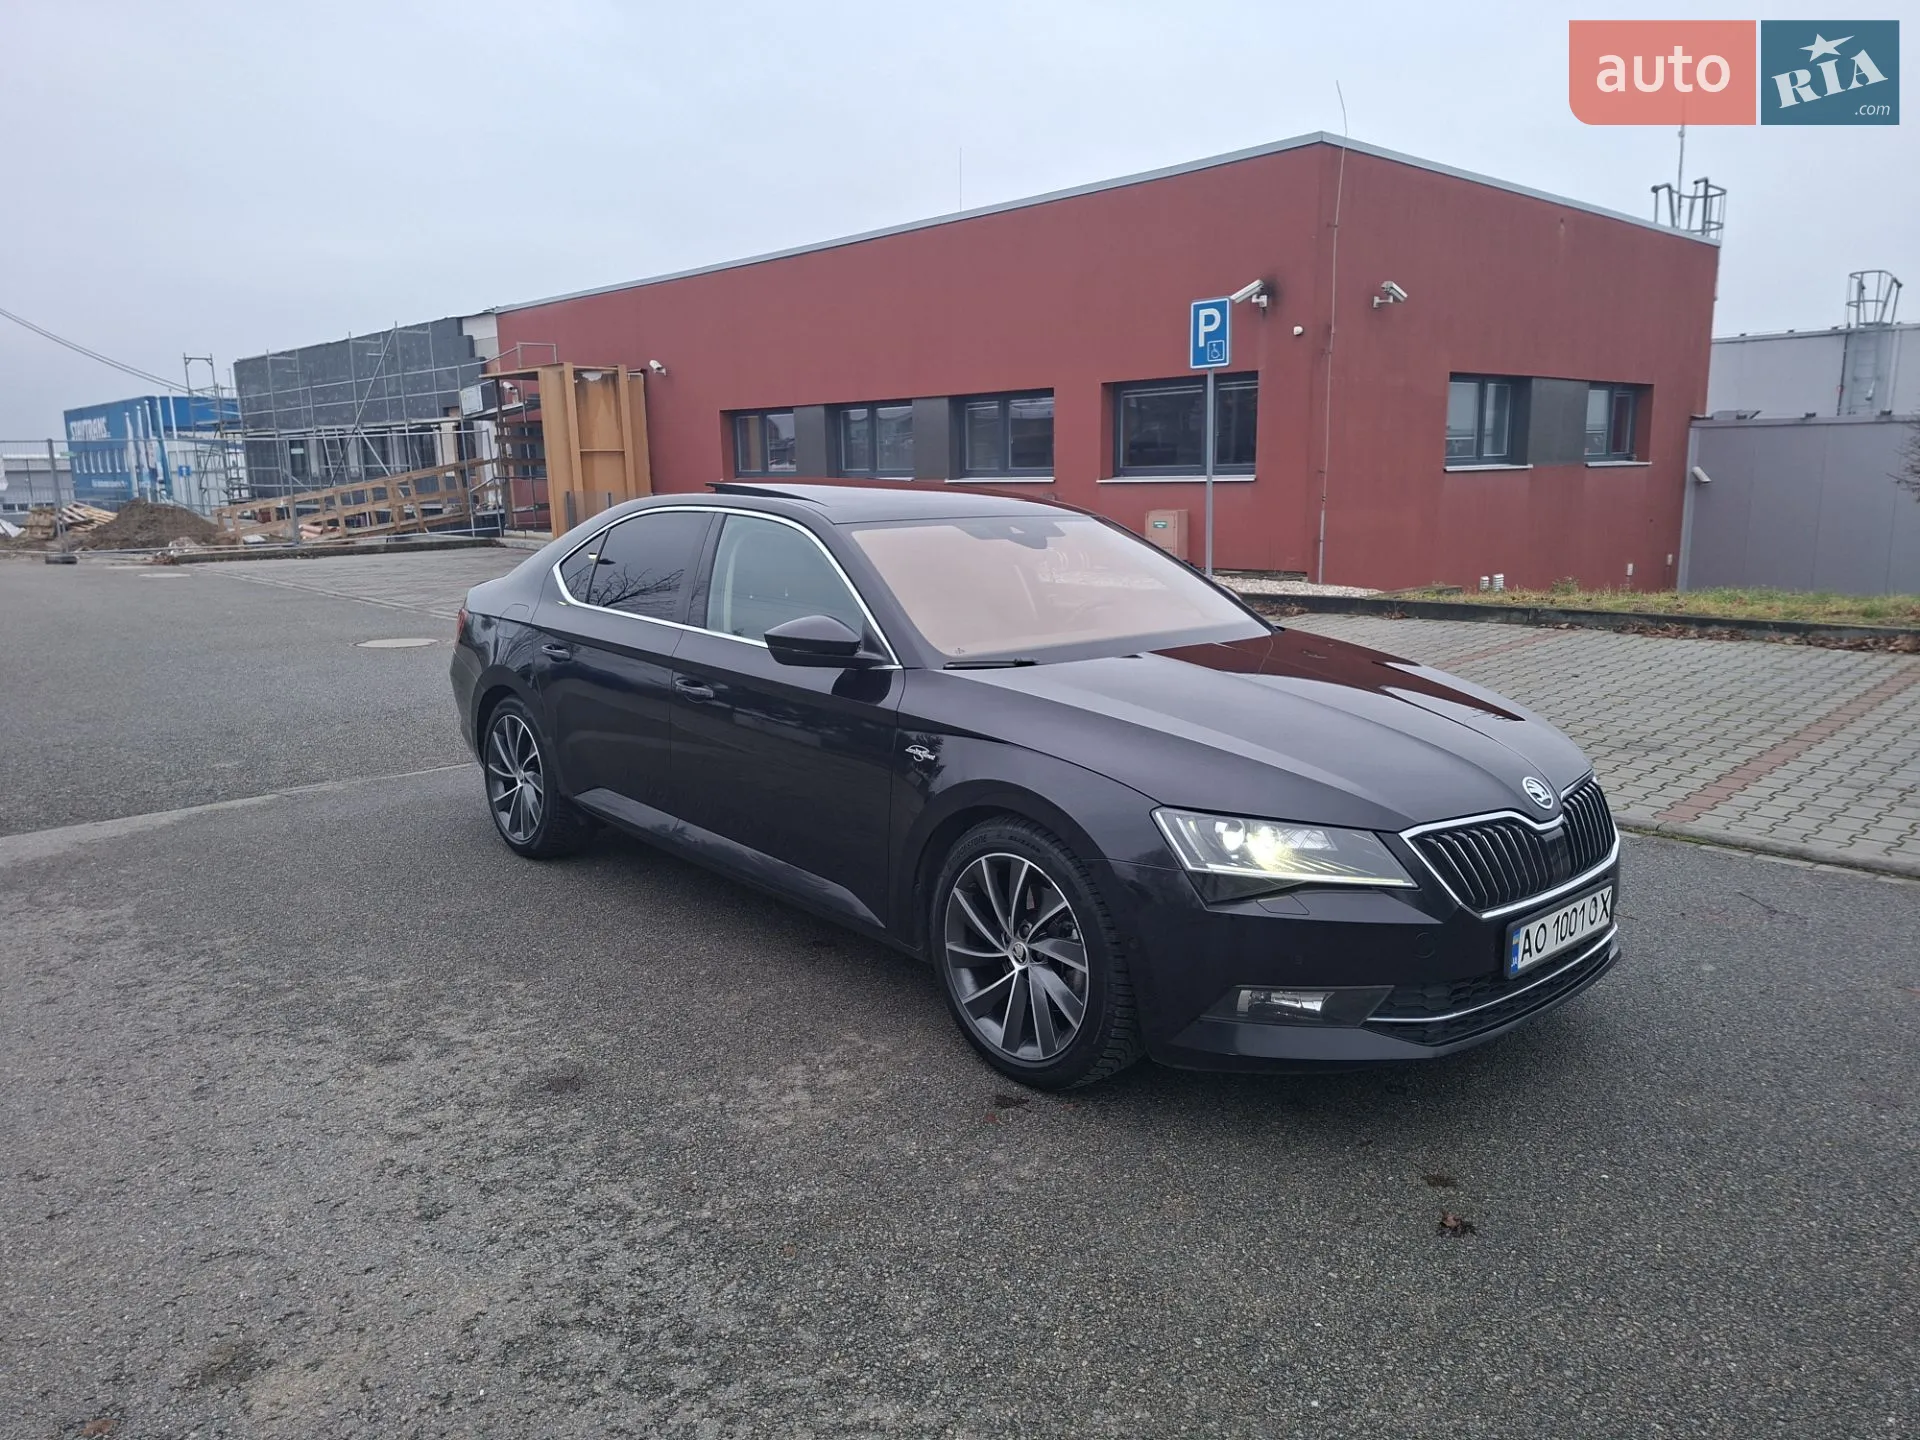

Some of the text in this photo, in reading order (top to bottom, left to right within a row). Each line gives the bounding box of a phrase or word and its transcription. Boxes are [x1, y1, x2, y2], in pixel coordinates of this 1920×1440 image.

[1198, 307, 1221, 347] P
[1521, 889, 1612, 962] AO 1001 OX
